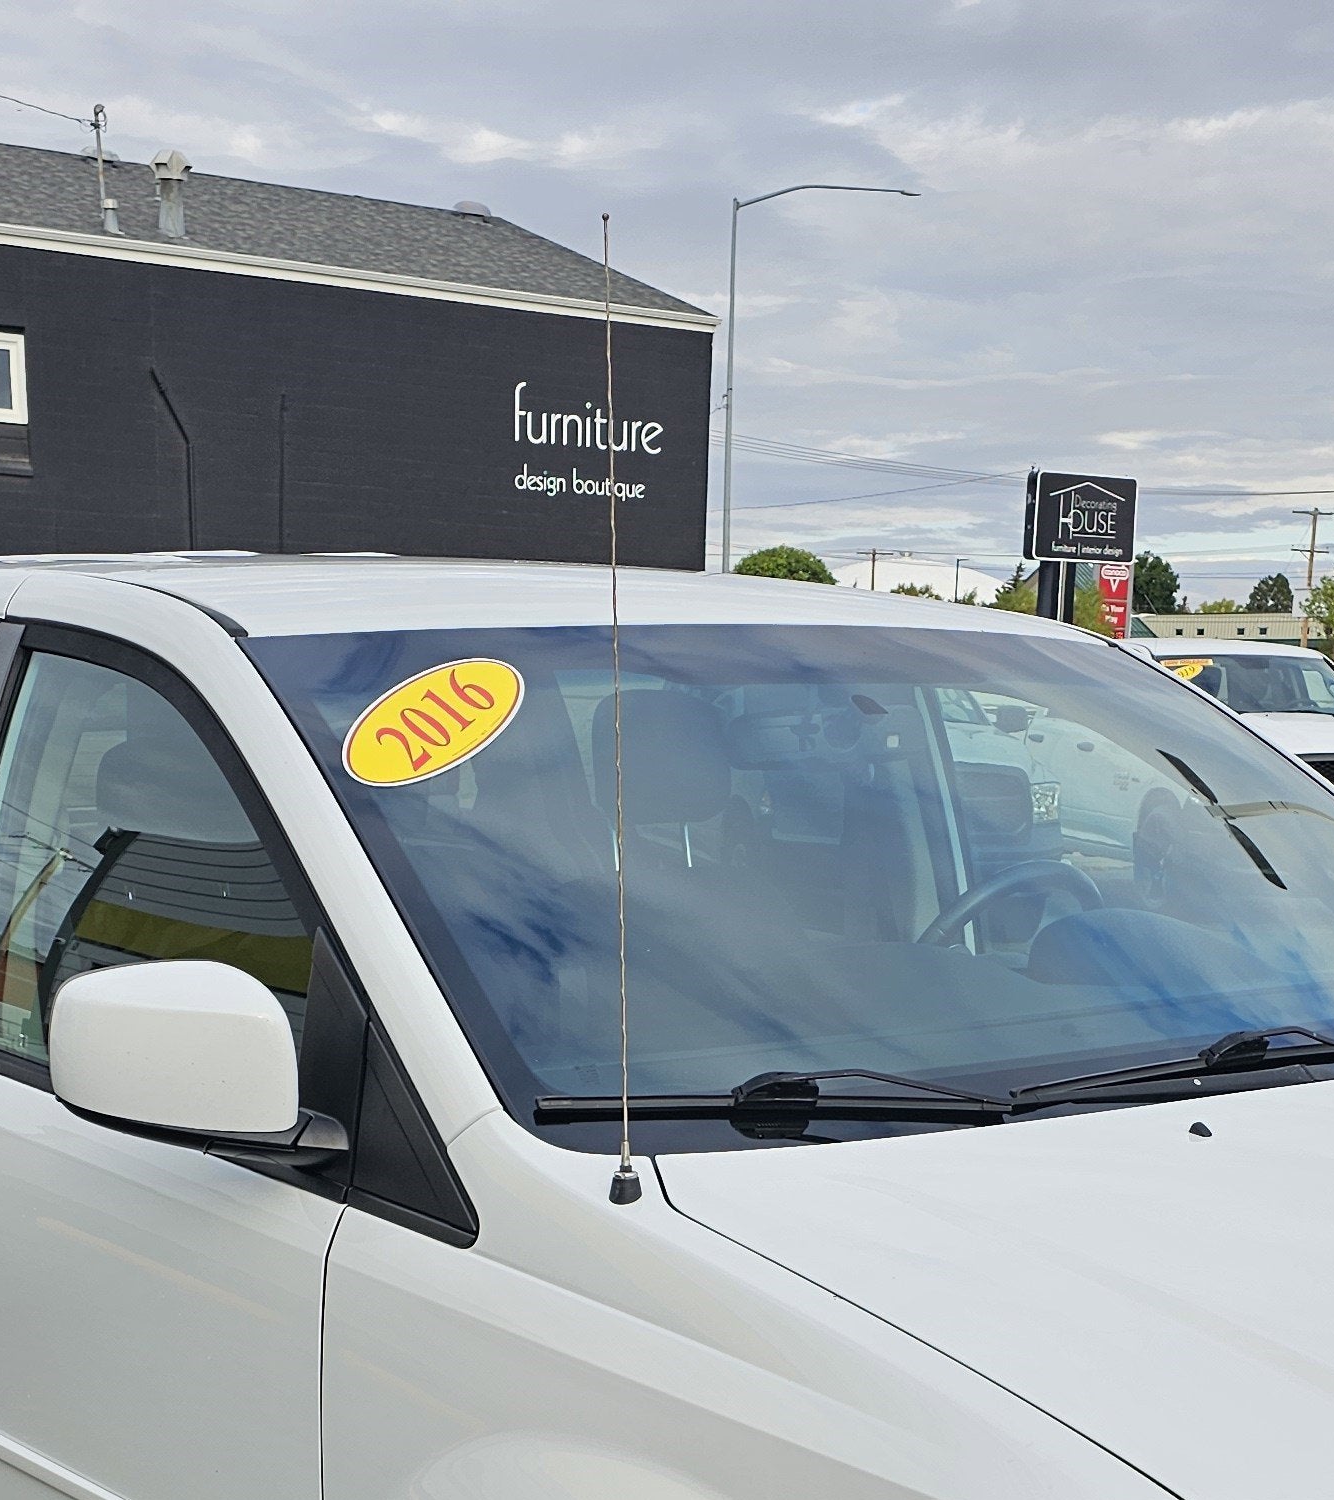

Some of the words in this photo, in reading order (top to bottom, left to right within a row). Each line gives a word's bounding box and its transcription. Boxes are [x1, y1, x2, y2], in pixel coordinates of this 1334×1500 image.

[514, 381, 664, 455] furniture
[514, 463, 567, 497] design
[572, 467, 646, 502] boutque
[1075, 494, 1118, 513] Decorating
[1103, 545, 1123, 558] design
[376, 668, 496, 772] 2016
